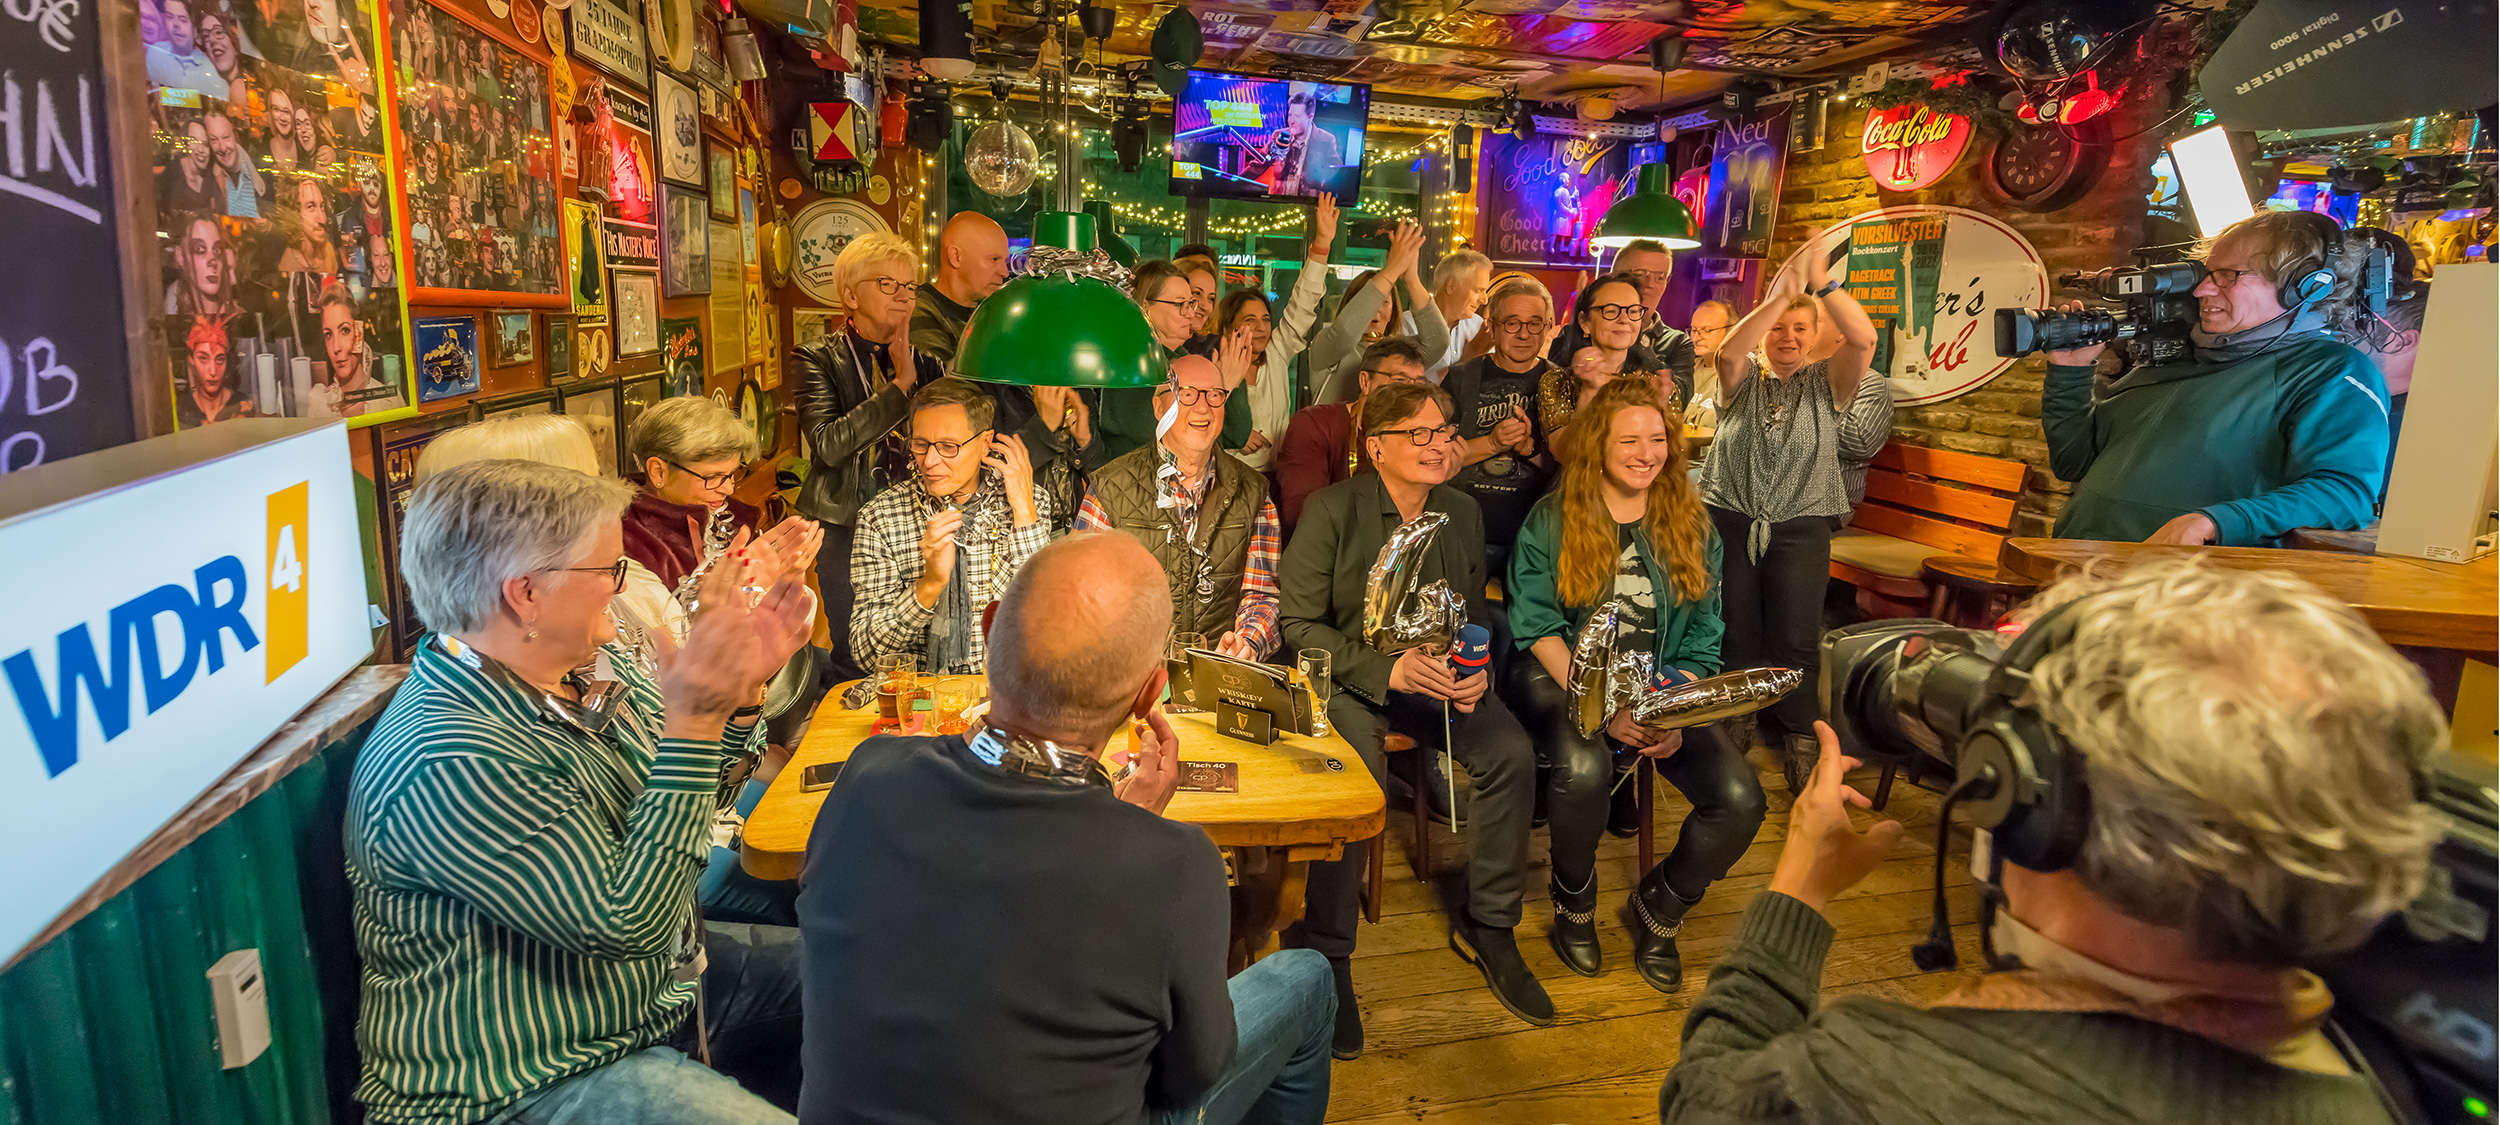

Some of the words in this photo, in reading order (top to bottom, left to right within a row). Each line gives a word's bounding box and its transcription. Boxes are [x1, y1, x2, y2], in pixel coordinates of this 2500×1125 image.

[600, 7, 633, 44] JAHRE
[1202, 11, 1239, 24] ROT
[2301, 12, 2340, 36] Digital
[576, 20, 644, 76] GRAMMOPHON
[2270, 31, 2300, 50] 9000
[2046, 36, 2070, 78] SENNHEI
[2235, 26, 2369, 95] SENNHEISER
[1204, 99, 1229, 111] TOP
[1230, 101, 1253, 113] 444
[1721, 114, 1770, 149] Neu
[1862, 105, 1953, 154] Coca-Cola
[1178, 163, 1196, 171] TOP
[1185, 170, 1200, 178] 444
[1504, 144, 1557, 192] Good
[832, 215, 849, 225] 125
[1500, 208, 1543, 232] Good
[1500, 233, 1547, 254] Cheer
[1853, 221, 1943, 246] VORSILVESTER
[1852, 245, 1899, 255] Rockkonzert
[1849, 269, 1896, 282] RAGETRACK
[2124, 277, 2133, 292] 1
[1848, 287, 1870, 300] LATIN
[1871, 287, 1897, 300] GREEK
[2, 554, 260, 780] WDR
[270, 524, 303, 594] 4
[1228, 697, 1258, 710] KARTE
[1229, 726, 1255, 739] GUINNESS
